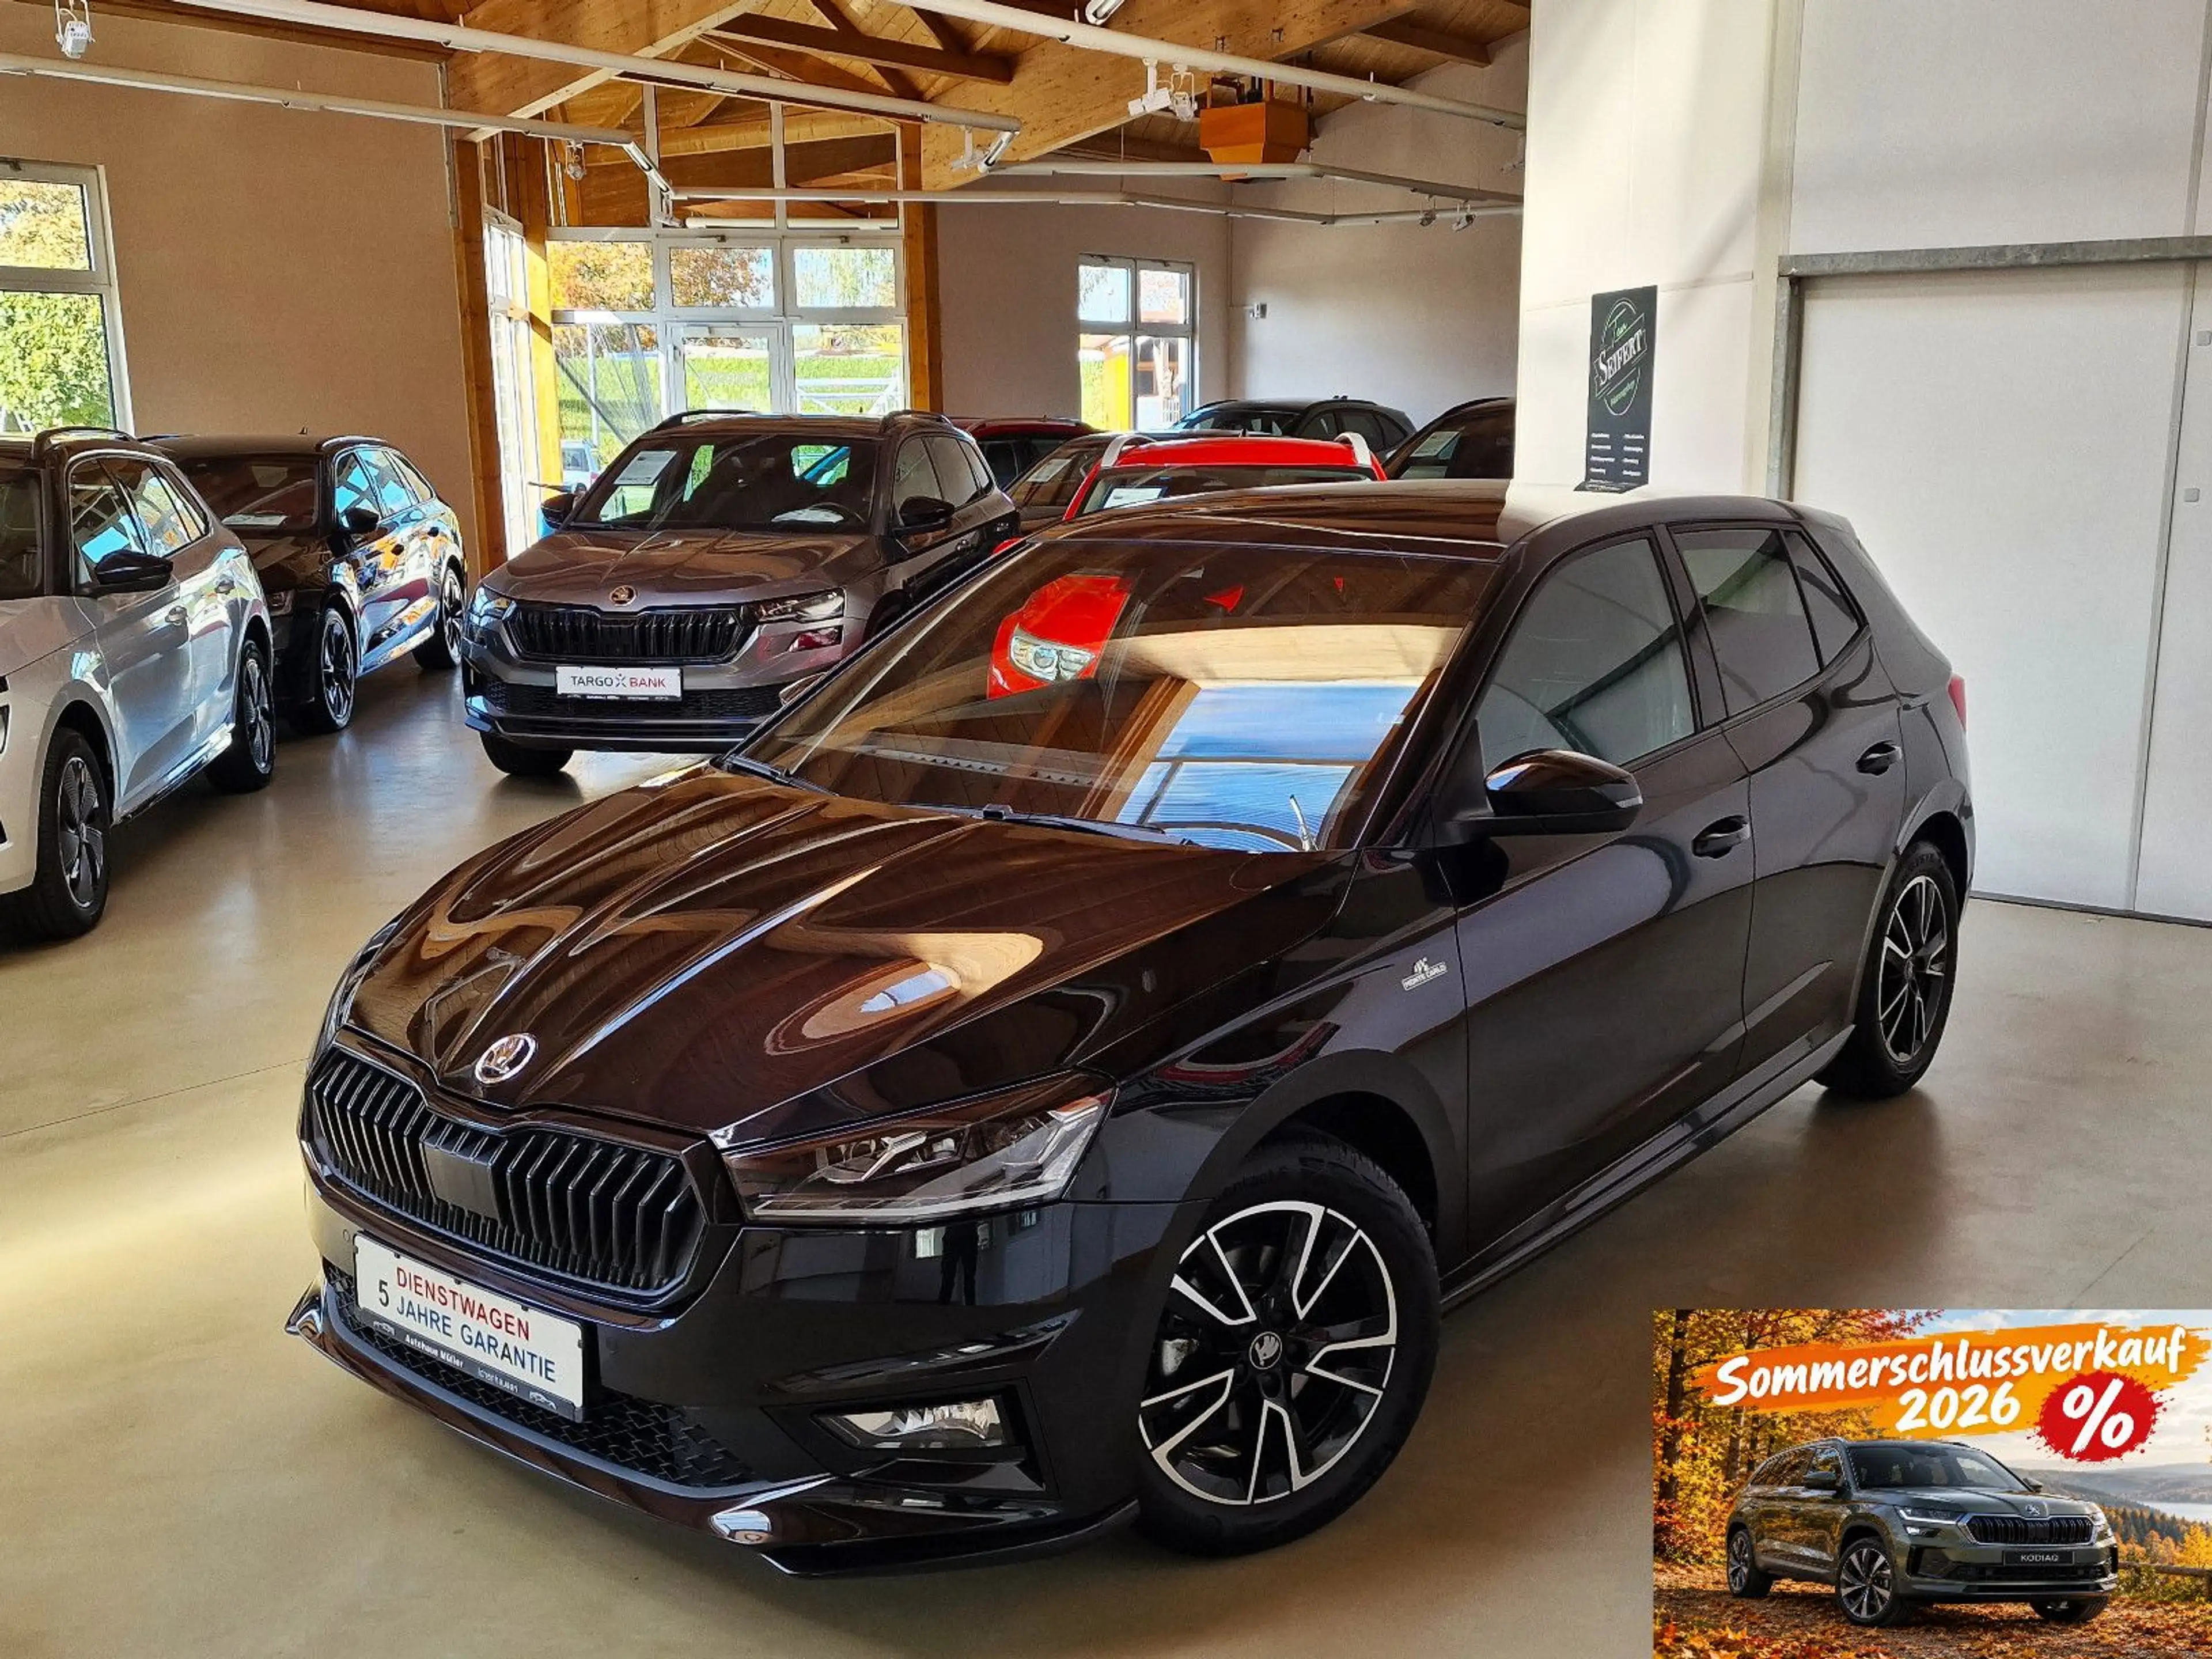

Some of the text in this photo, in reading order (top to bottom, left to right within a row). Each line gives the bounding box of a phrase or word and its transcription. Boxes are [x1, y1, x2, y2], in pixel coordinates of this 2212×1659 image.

[1600, 328, 1642, 387] SEIFERT
[571, 676, 666, 688] TARGO BANK
[378, 1279, 389, 1307] 5
[396, 1296, 452, 1337] JAHRE
[460, 1324, 556, 1382] GARANTIE
[396, 1267, 530, 1340] DIENSTWAGEN
